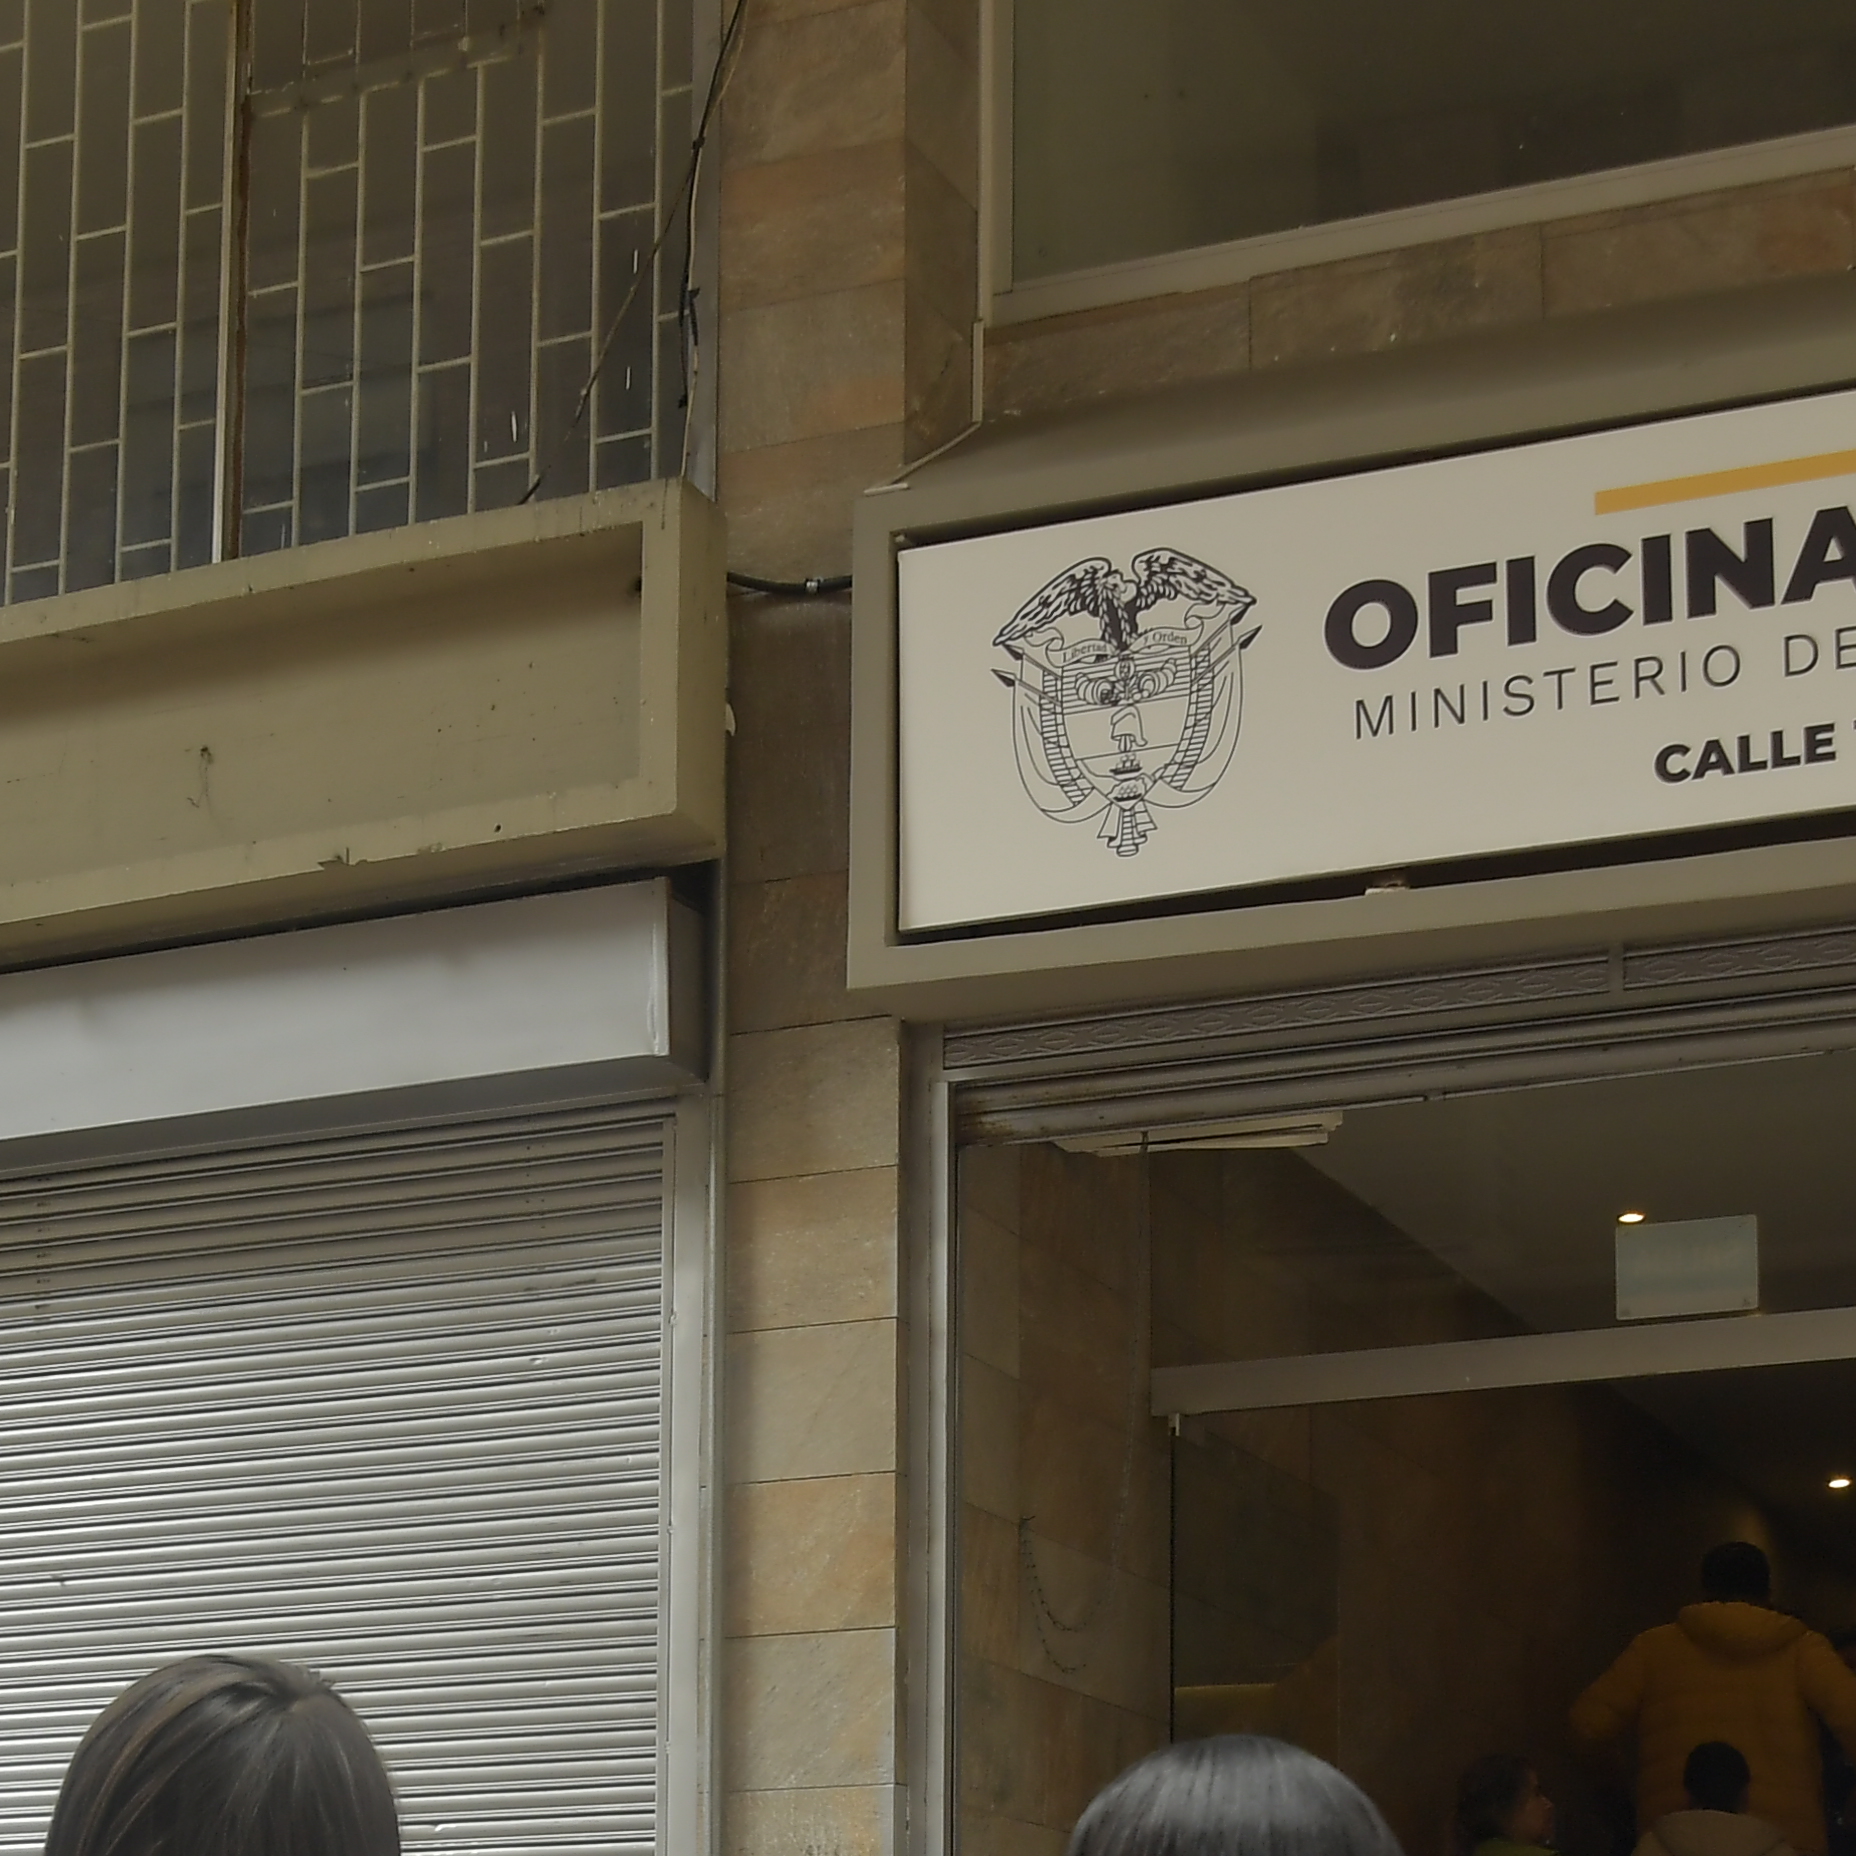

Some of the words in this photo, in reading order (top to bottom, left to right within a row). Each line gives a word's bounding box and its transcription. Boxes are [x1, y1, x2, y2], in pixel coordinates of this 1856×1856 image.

[1152, 631, 1188, 645] Orden
[1354, 644, 1742, 740] MINISTERIO
[1654, 722, 1837, 783] CALLE
